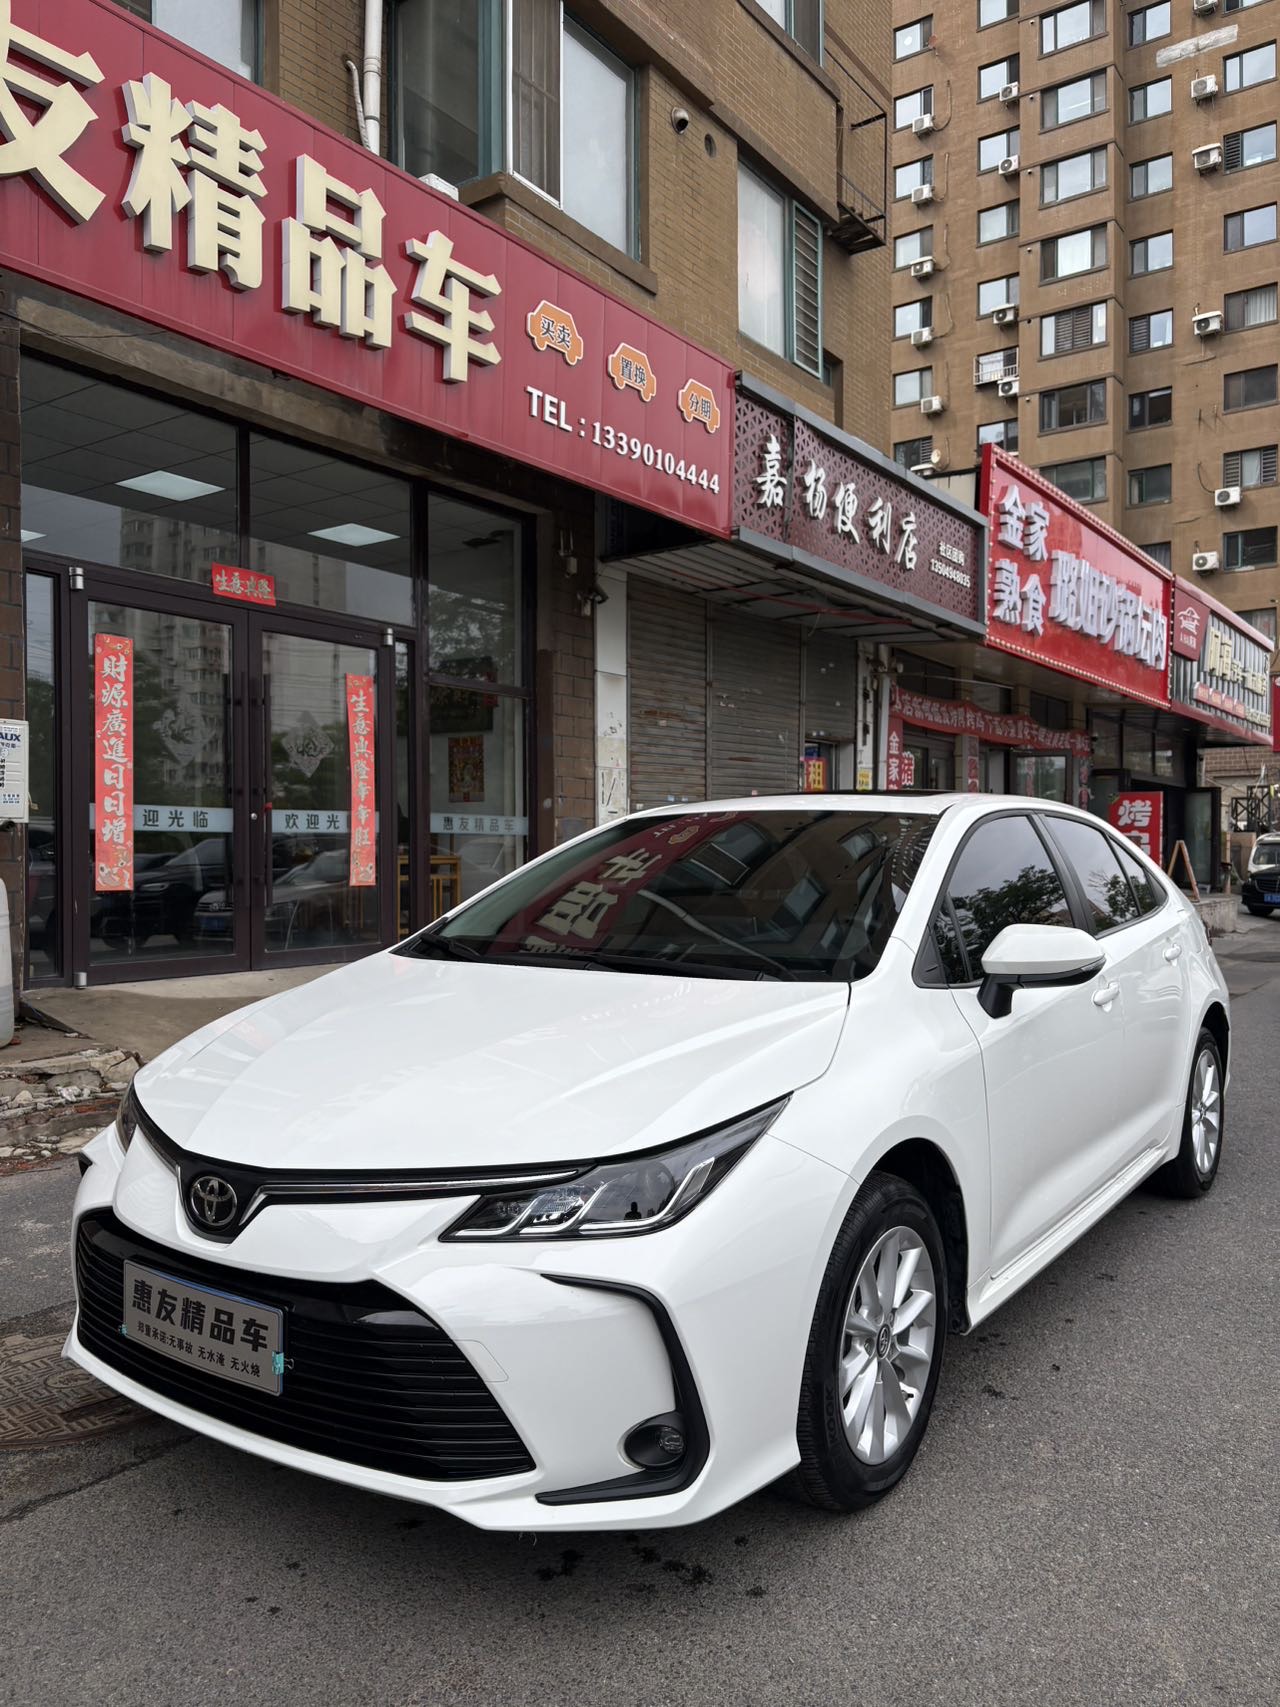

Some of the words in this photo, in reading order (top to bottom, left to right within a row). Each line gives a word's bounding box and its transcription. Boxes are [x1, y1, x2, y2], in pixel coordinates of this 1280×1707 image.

[541, 316, 572, 348] 买卖
[620, 356, 647, 387] 置换
[688, 393, 712, 420] 分期
[592, 422, 720, 494] 13390104444
[997, 484, 1050, 561] 金家
[994, 559, 1046, 636] 熟食
[888, 730, 900, 790] 金家
[142, 808, 209, 829] 迎光临
[284, 813, 341, 831] 欢迎光
[443, 816, 516, 832] 惠友精品车
[132, 1279, 269, 1353] 惠友精品车
[230, 1356, 261, 1378] 无火烧
